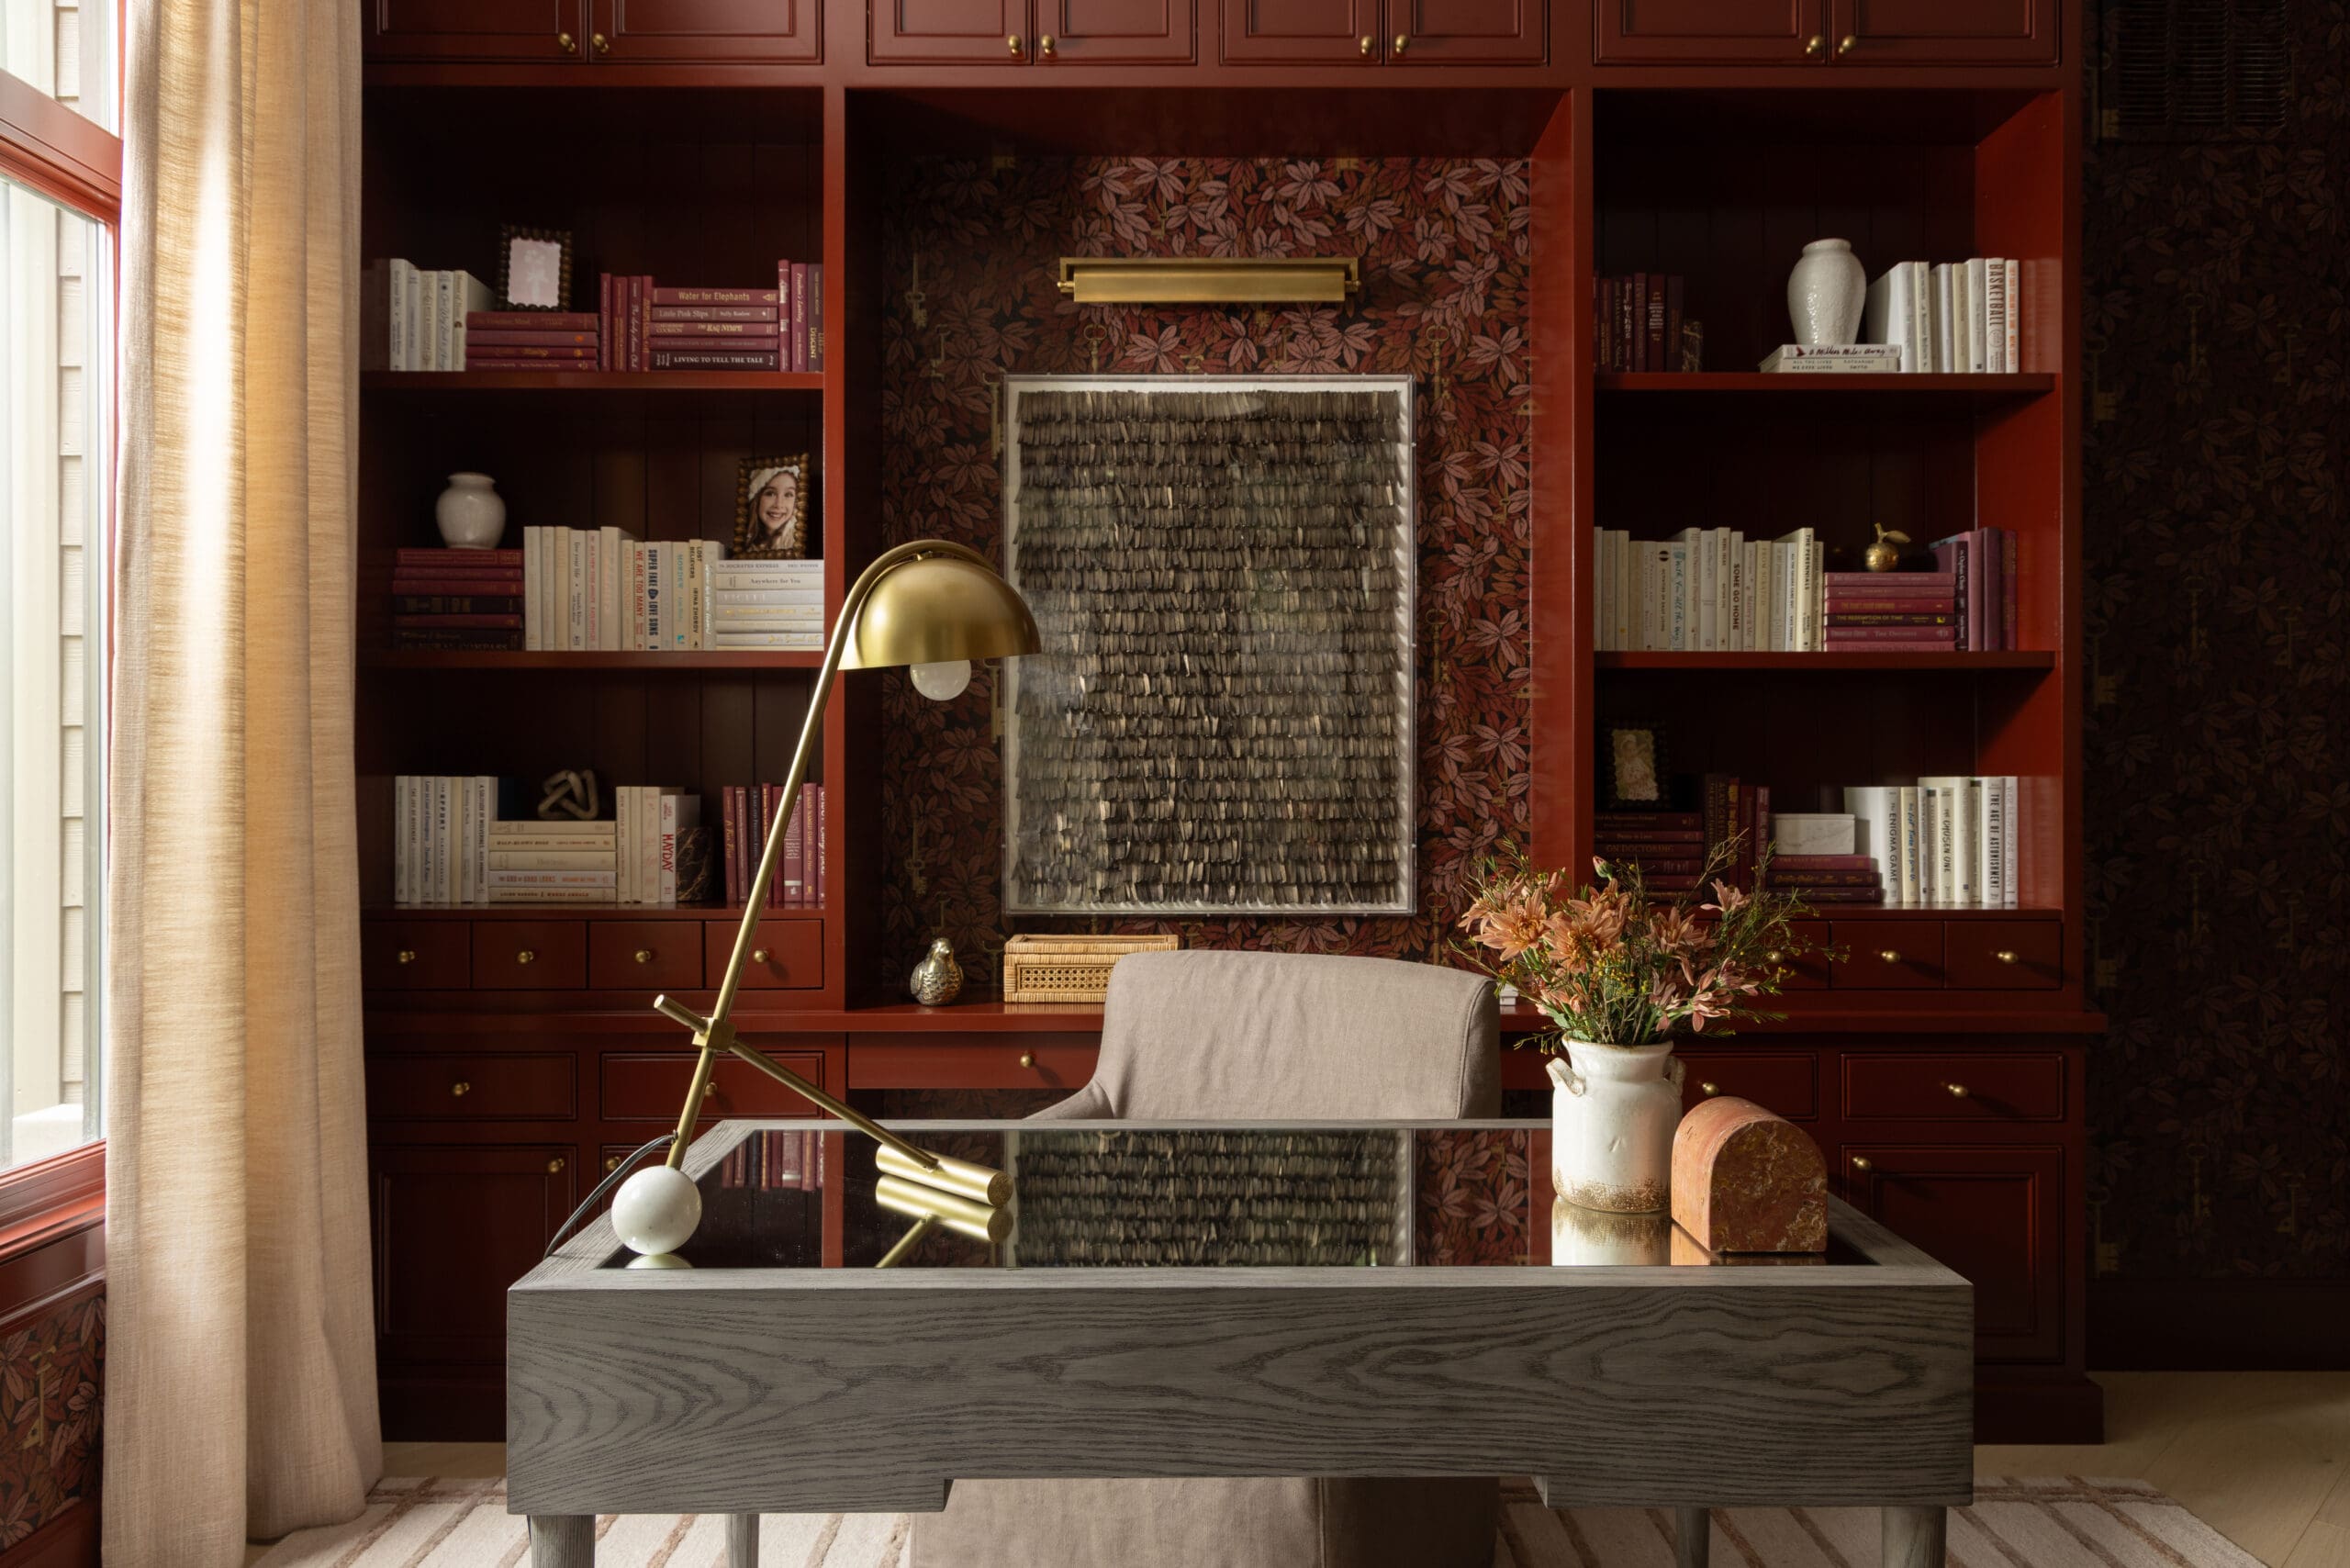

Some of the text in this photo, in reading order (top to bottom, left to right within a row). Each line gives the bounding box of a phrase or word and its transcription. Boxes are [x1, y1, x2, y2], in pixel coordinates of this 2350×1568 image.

[677, 292, 750, 302] Water for Elephants
[692, 308, 709, 319] Slips
[1989, 264, 2004, 326] BASKETBALL
[636, 551, 644, 617] WE ARE TOO MANY
[648, 549, 658, 636] SUPER FAKE LOVE SONG
[1733, 590, 1740, 602] GO
[662, 834, 674, 872] MAYDAY
[1889, 813, 1897, 882] ENIGMA GAME
[1942, 820, 1951, 853] CHOSEN
[1990, 794, 1999, 888] THE AGE OF ASTONISHMENT
